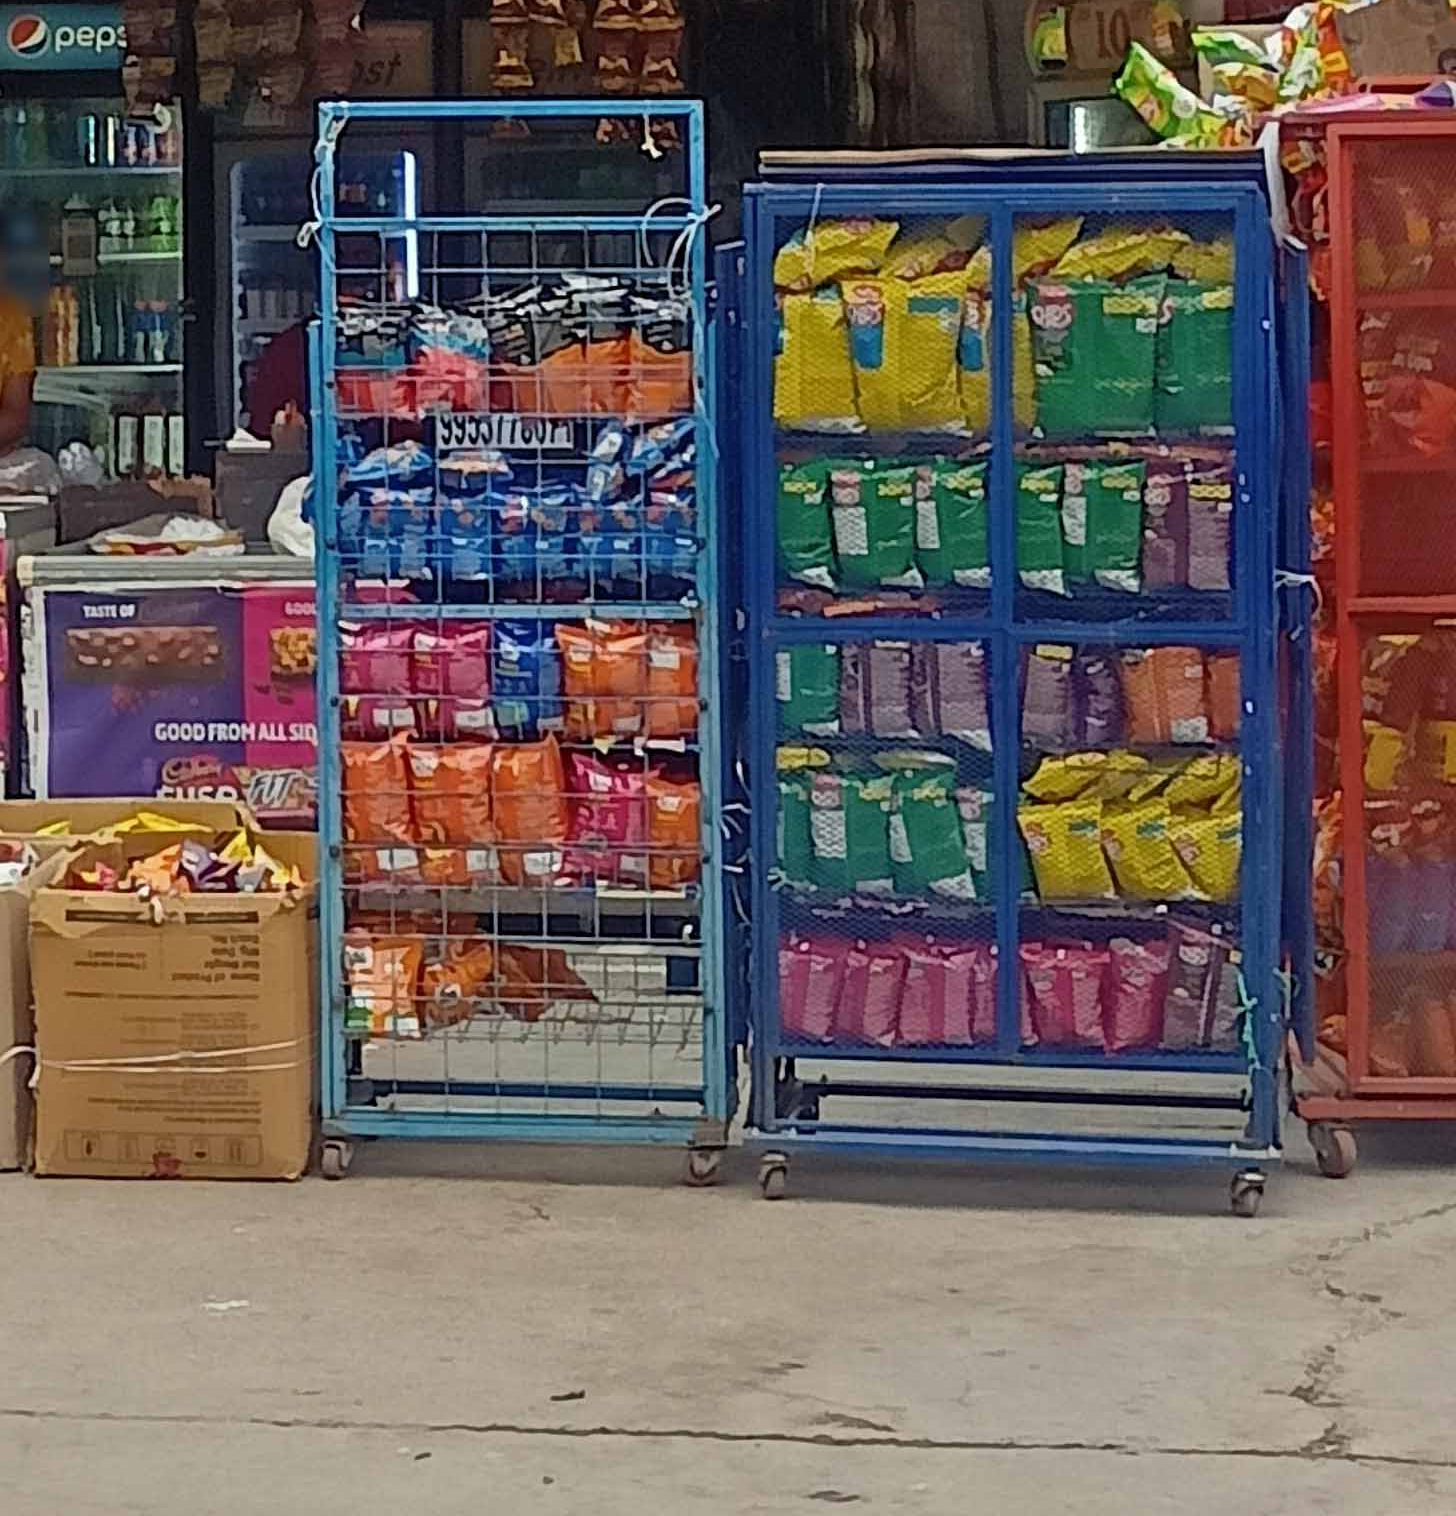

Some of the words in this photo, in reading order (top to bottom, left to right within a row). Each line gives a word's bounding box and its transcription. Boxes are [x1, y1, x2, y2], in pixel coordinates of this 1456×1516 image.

[55, 25, 128, 53] peps
[83, 604, 118, 619] TASTE
[119, 604, 136, 618] OF
[154, 722, 206, 741] GOOD
[208, 722, 255, 742] FROM
[257, 722, 287, 742] ALL
[288, 722, 318, 742] SID
